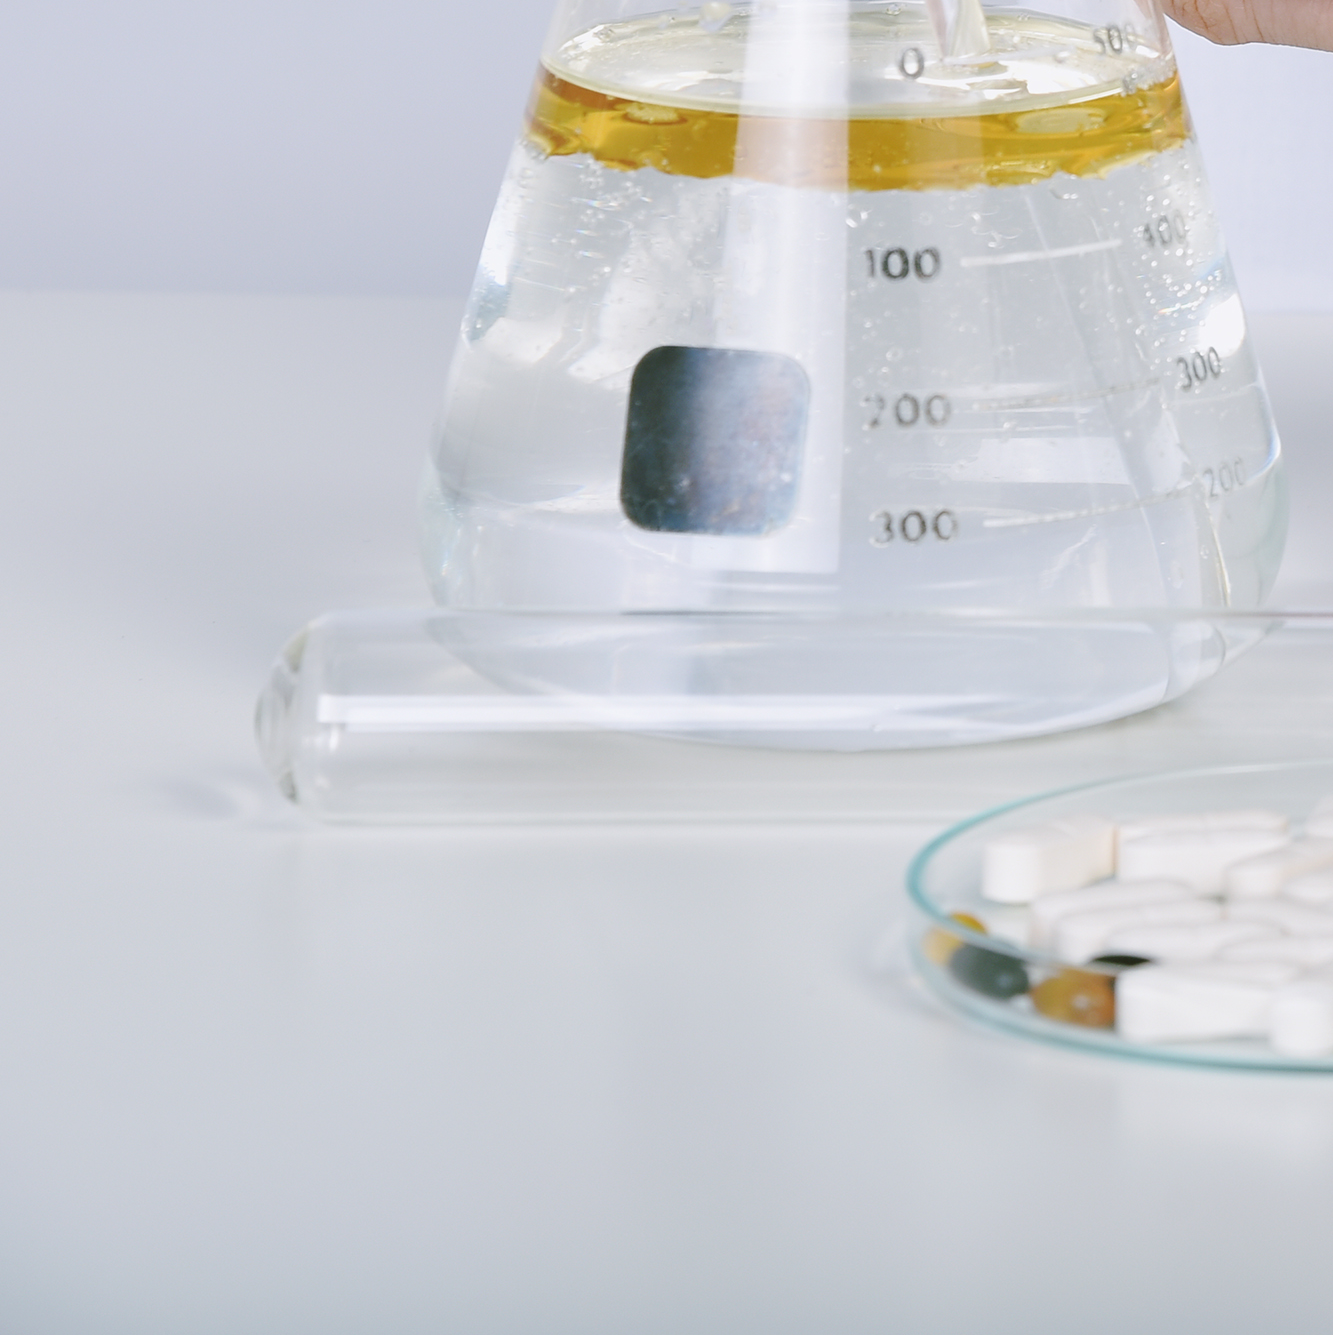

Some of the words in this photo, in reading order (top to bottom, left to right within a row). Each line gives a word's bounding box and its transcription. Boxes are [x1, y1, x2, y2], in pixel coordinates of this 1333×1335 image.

[900, 47, 925, 80] 0
[865, 246, 941, 281] 100
[1176, 346, 1222, 392] 300
[863, 393, 951, 428] 200
[1203, 457, 1246, 497] 200
[869, 509, 958, 548] 300
